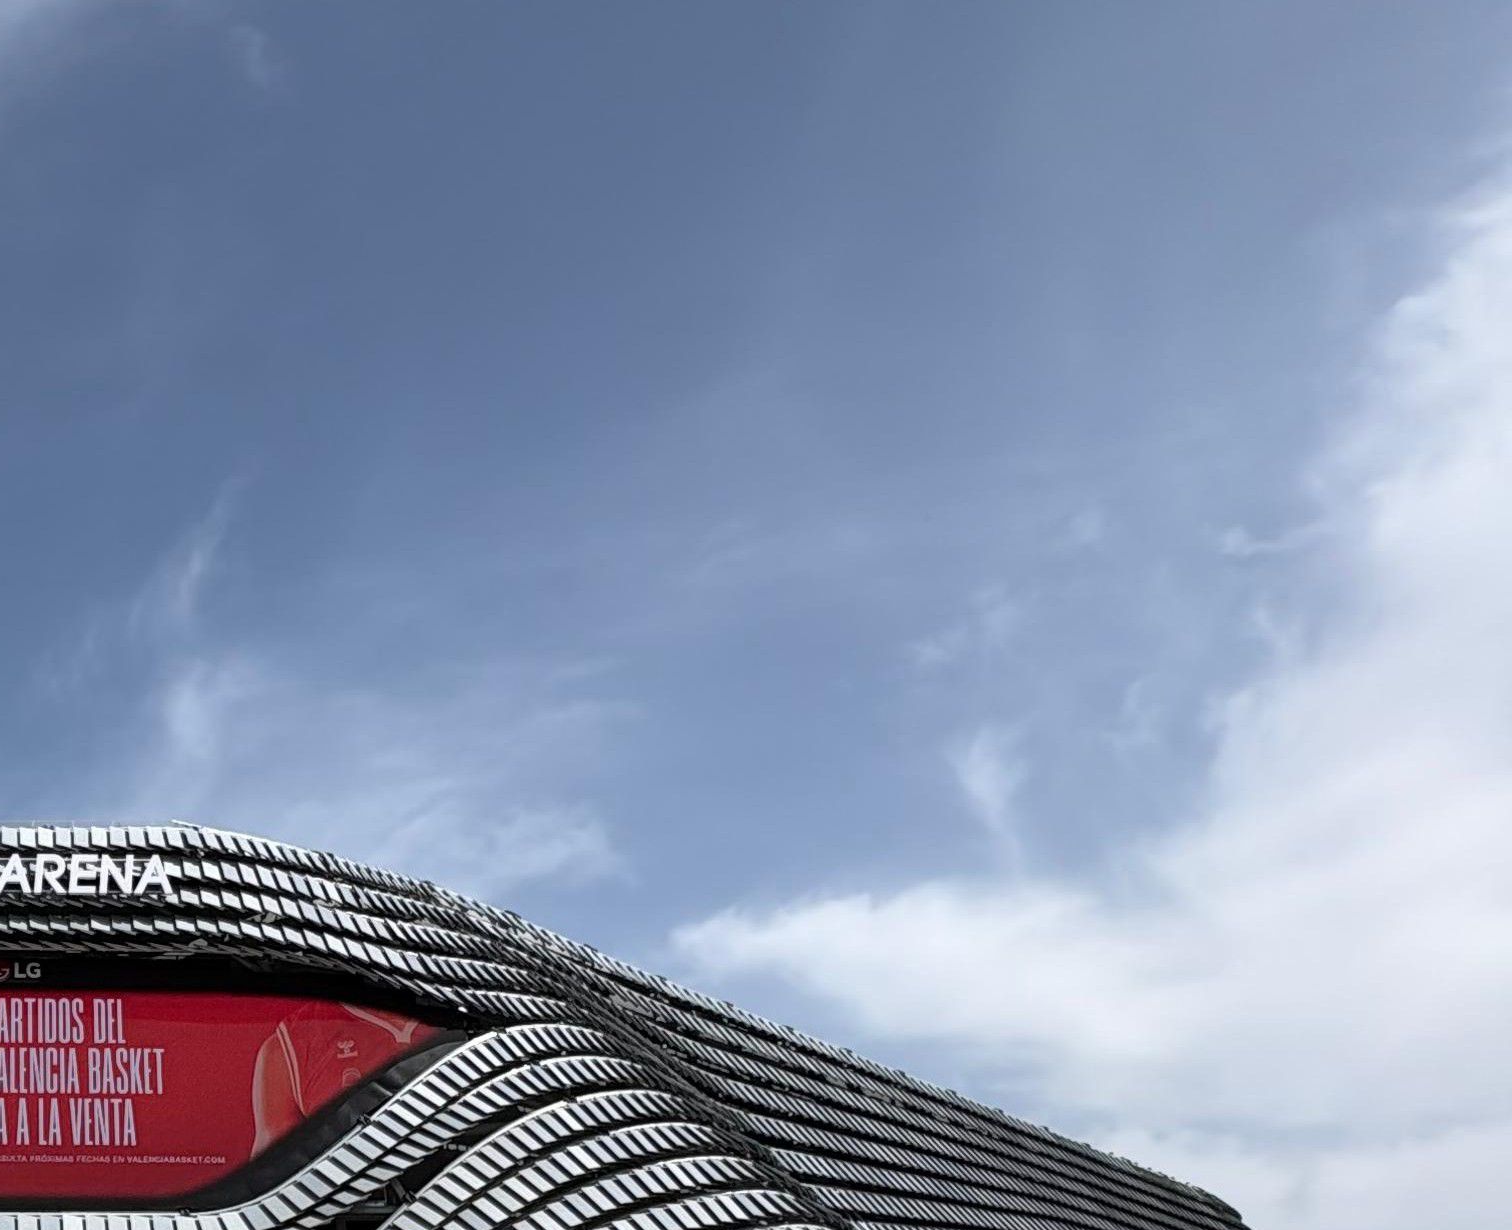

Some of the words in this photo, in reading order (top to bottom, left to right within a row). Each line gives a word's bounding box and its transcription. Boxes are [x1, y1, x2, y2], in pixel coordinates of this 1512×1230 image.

[13, 962, 41, 979] LG
[92, 998, 126, 1044] DEL
[88, 1048, 165, 1095] BASKET
[16, 1098, 30, 1145] A
[38, 1098, 62, 1145] LA
[70, 1098, 137, 1146] VENTA
